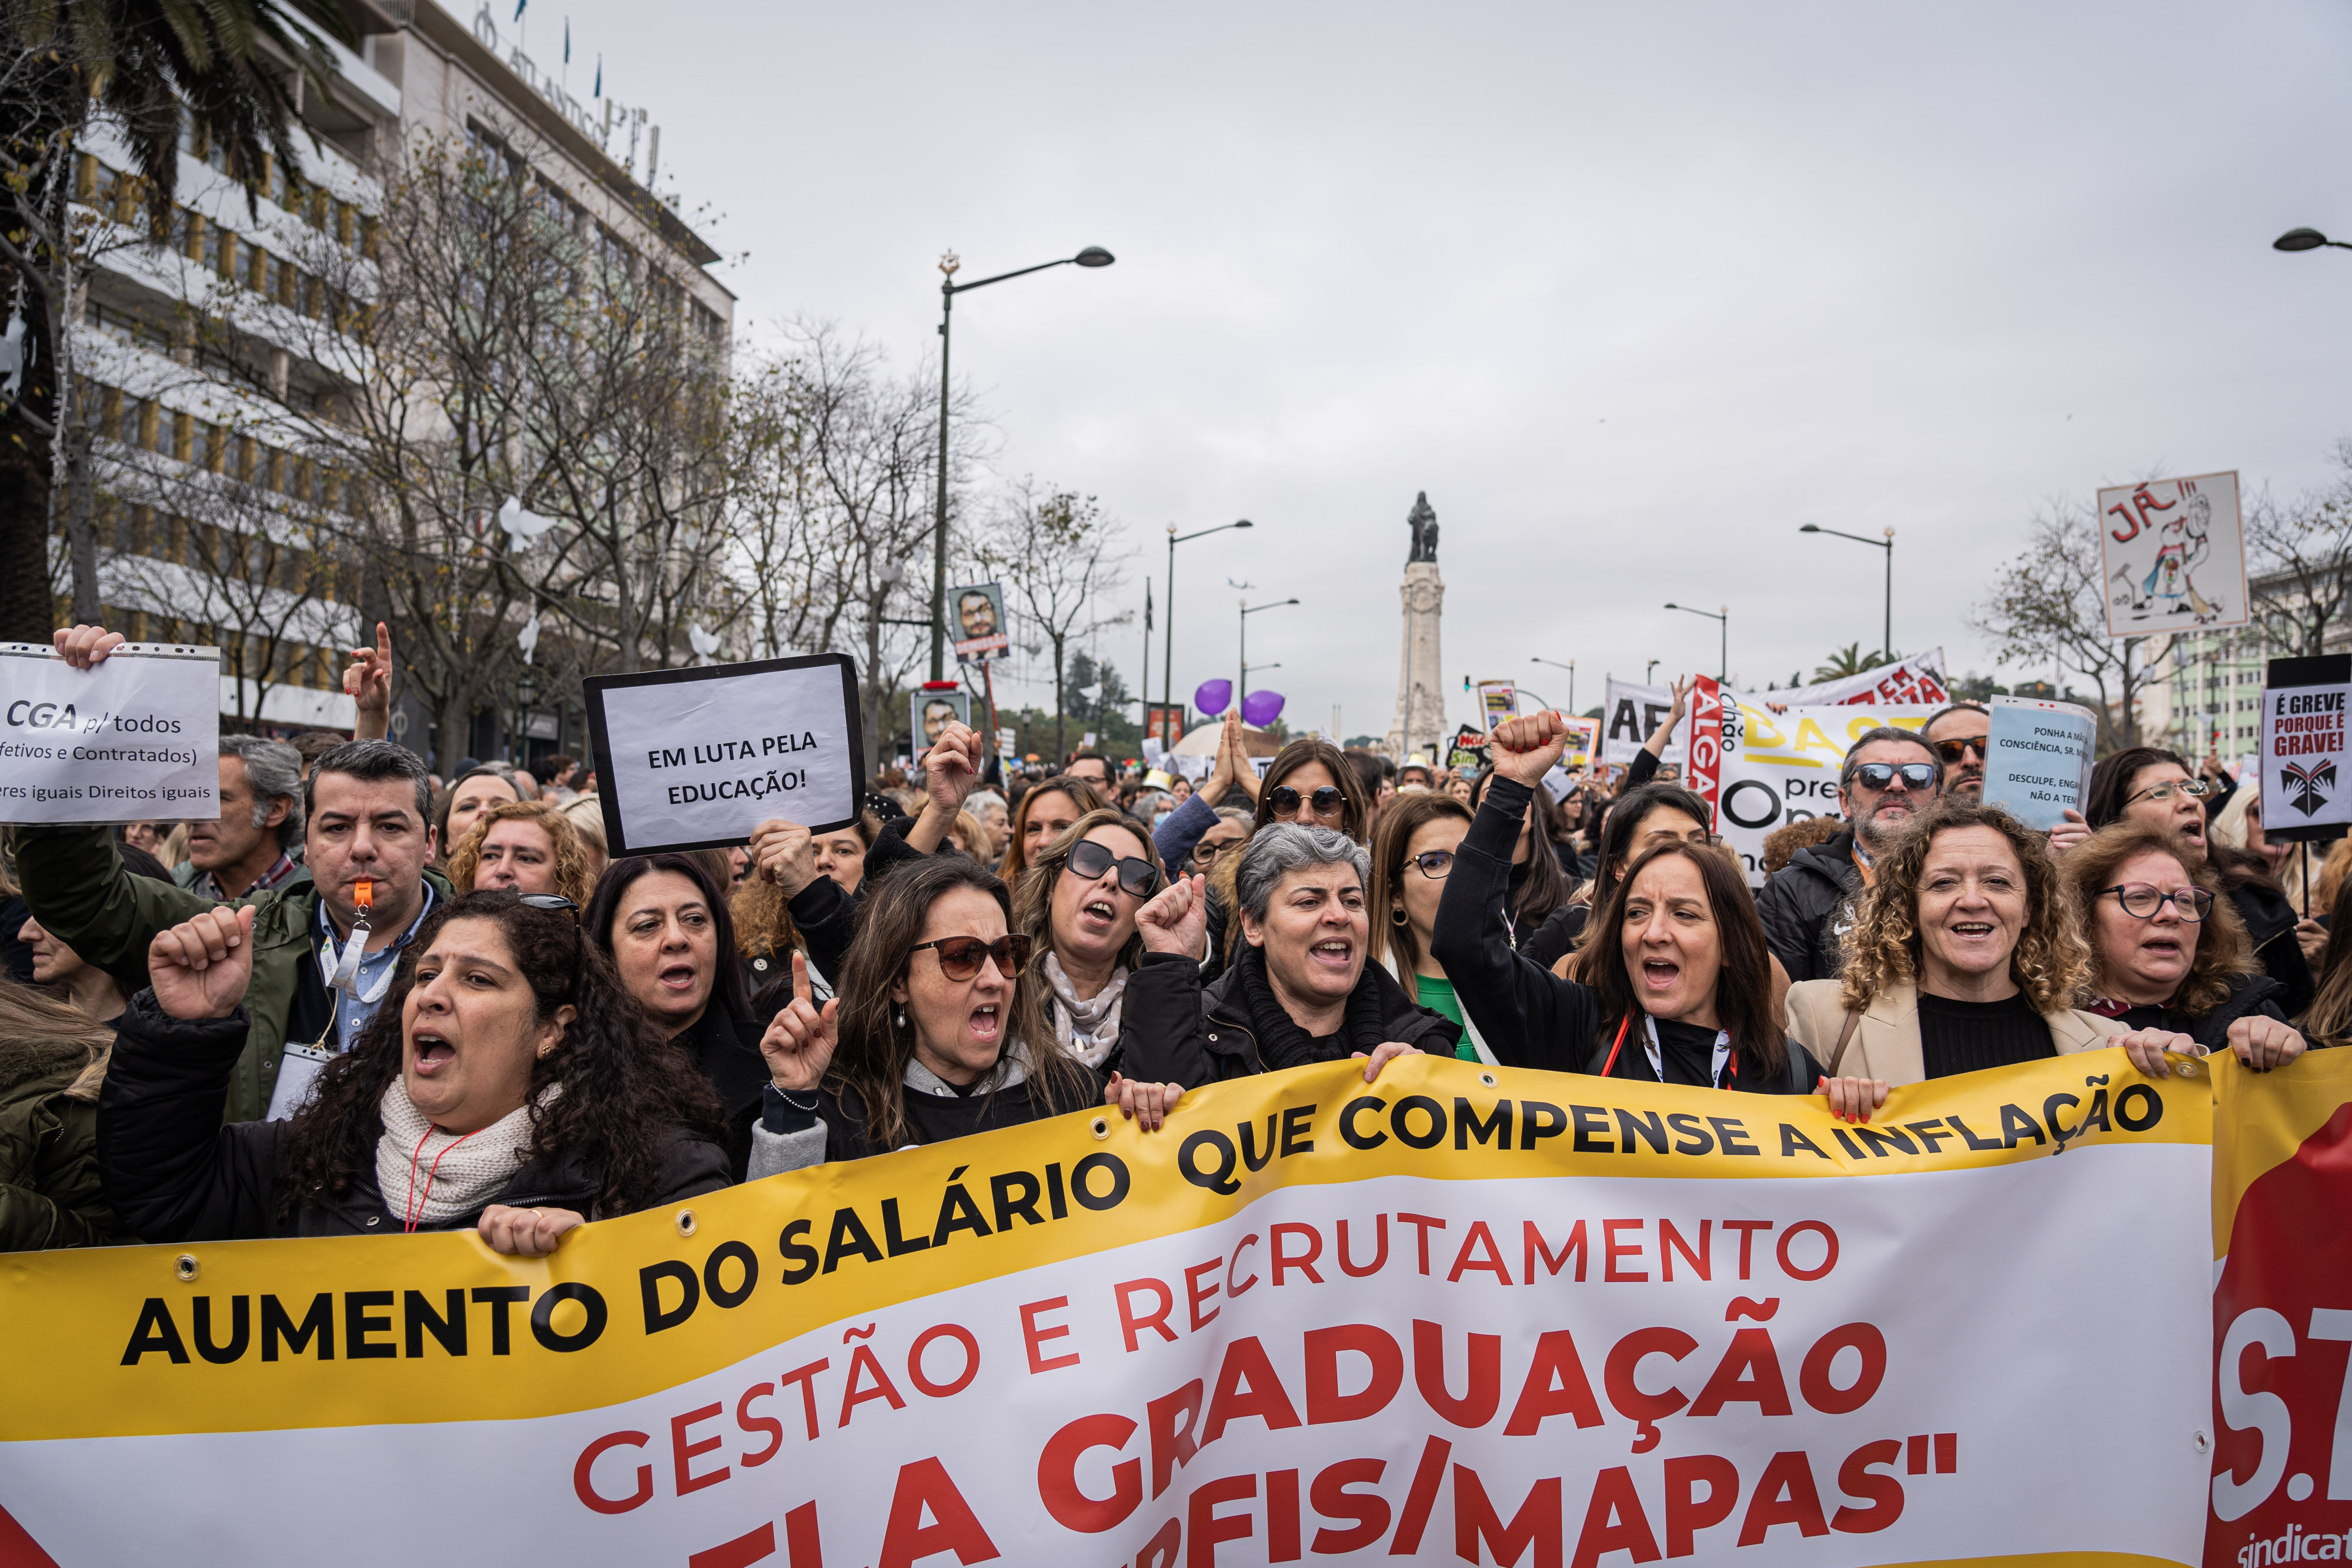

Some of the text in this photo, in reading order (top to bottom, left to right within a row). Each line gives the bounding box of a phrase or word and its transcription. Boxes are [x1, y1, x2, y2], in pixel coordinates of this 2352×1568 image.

[2276, 692, 2346, 716] É GREVE
[7, 700, 181, 734] CGA p/ todos
[2274, 710, 2344, 734] PORQUE É
[2034, 727, 2066, 739] PONHA
[2067, 731, 2072, 740] A
[2274, 731, 2344, 757] GRAVE!
[58, 749, 67, 760] e
[73, 746, 198, 766] Contratados)
[648, 731, 818, 769] EM LUTA PELA
[2000, 739, 2075, 755] CONSCIÊNCIA, SR.
[668, 769, 806, 805] EDUCAÇÃO!
[2009, 773, 2057, 788] DESCULPE,
[0, 785, 211, 802] res iguais Direitos iguais
[1721, 780, 1782, 829] O
[2030, 791, 2051, 801] NÃO
[120, 1074, 2164, 1366] AUMENTO DO SALÁRIO QUE COMPENSE A INFLAÇÃO
[574, 1213, 1839, 1515] GESTÃO E RECRUTAMENTO
[1037, 1296, 1887, 1534] GRADUAÇÃO
